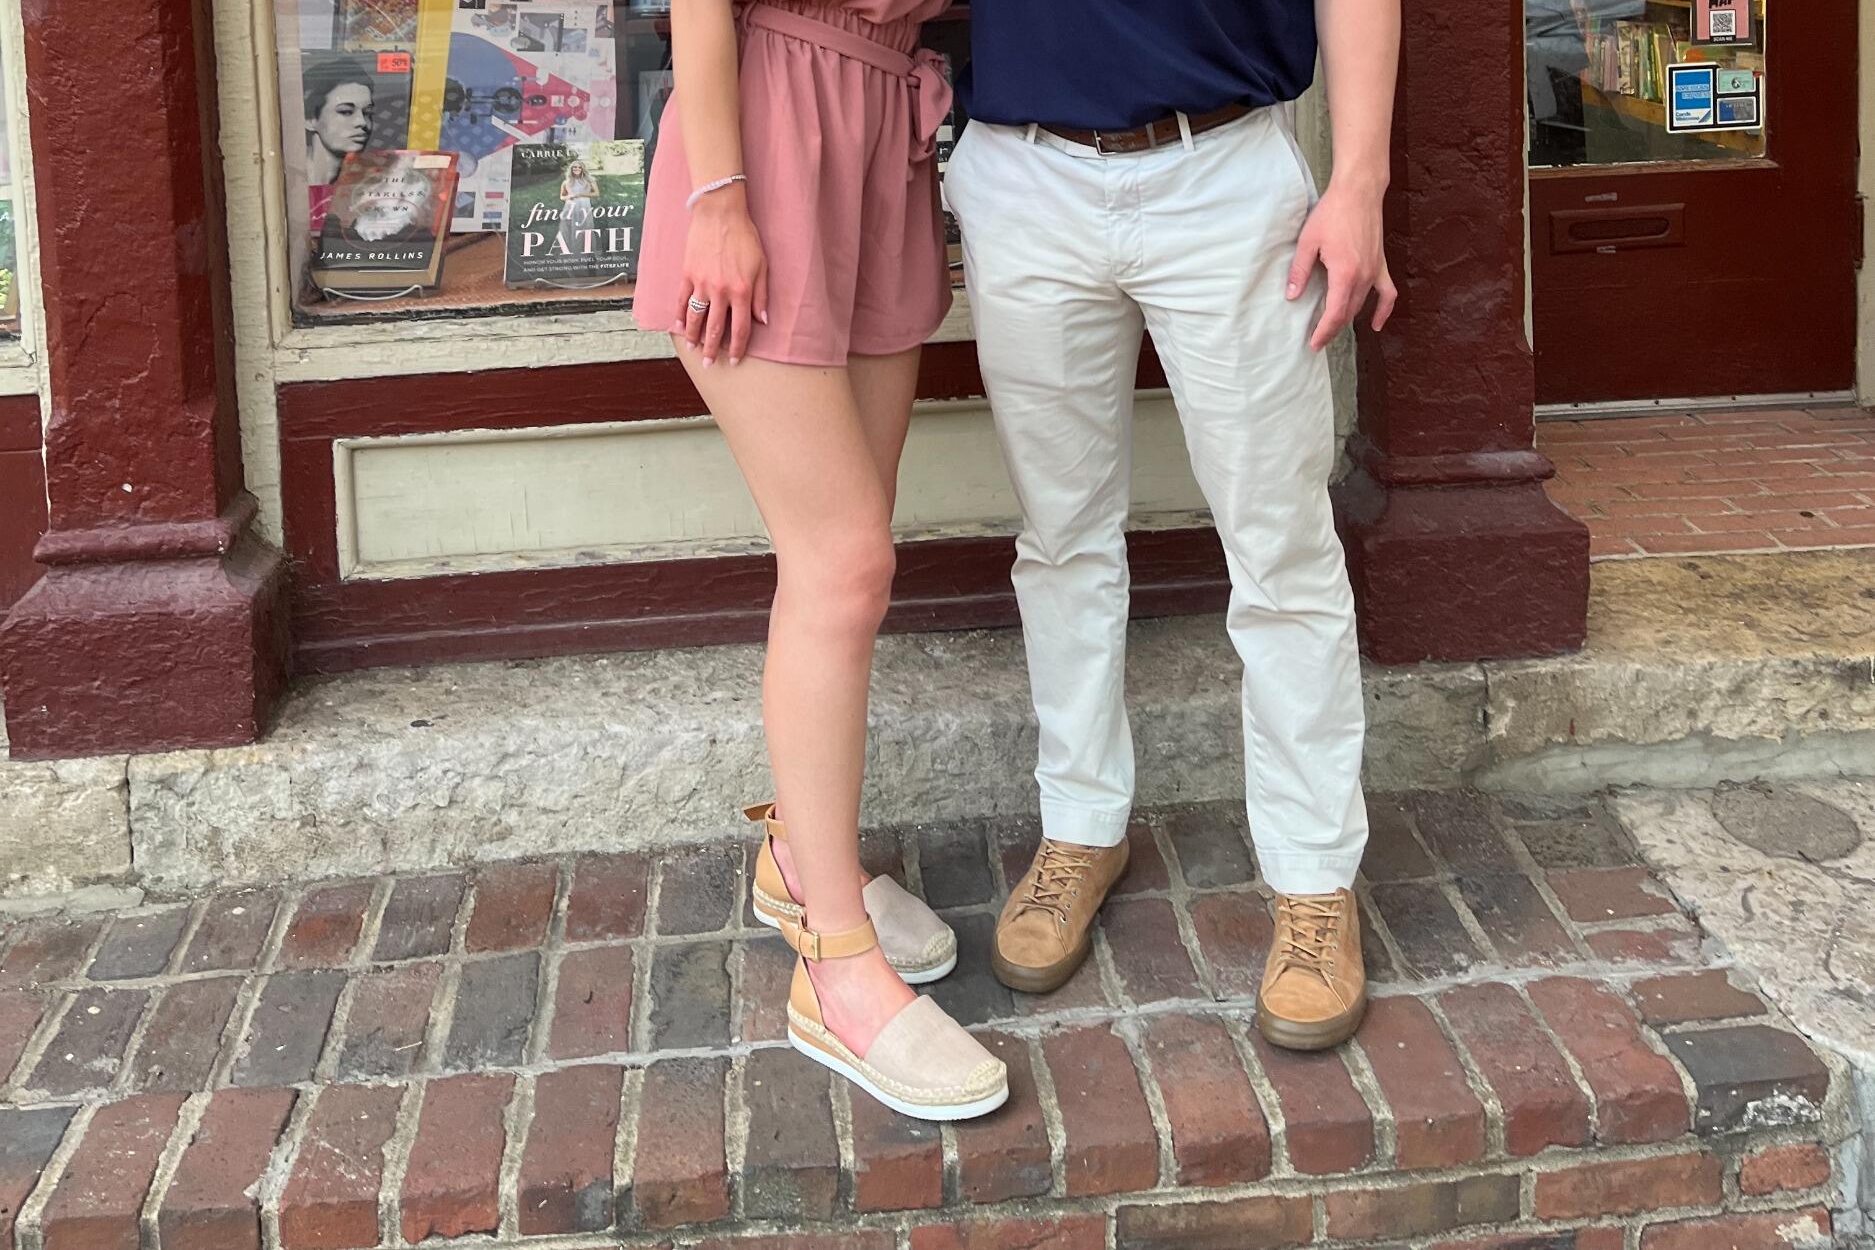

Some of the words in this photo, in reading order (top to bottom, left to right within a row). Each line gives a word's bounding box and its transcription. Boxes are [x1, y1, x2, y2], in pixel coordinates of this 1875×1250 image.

[521, 202, 576, 229] find
[575, 204, 634, 227] your
[520, 227, 634, 257] PATH
[320, 252, 361, 260] JAMES
[368, 252, 424, 260] ROLLINS
